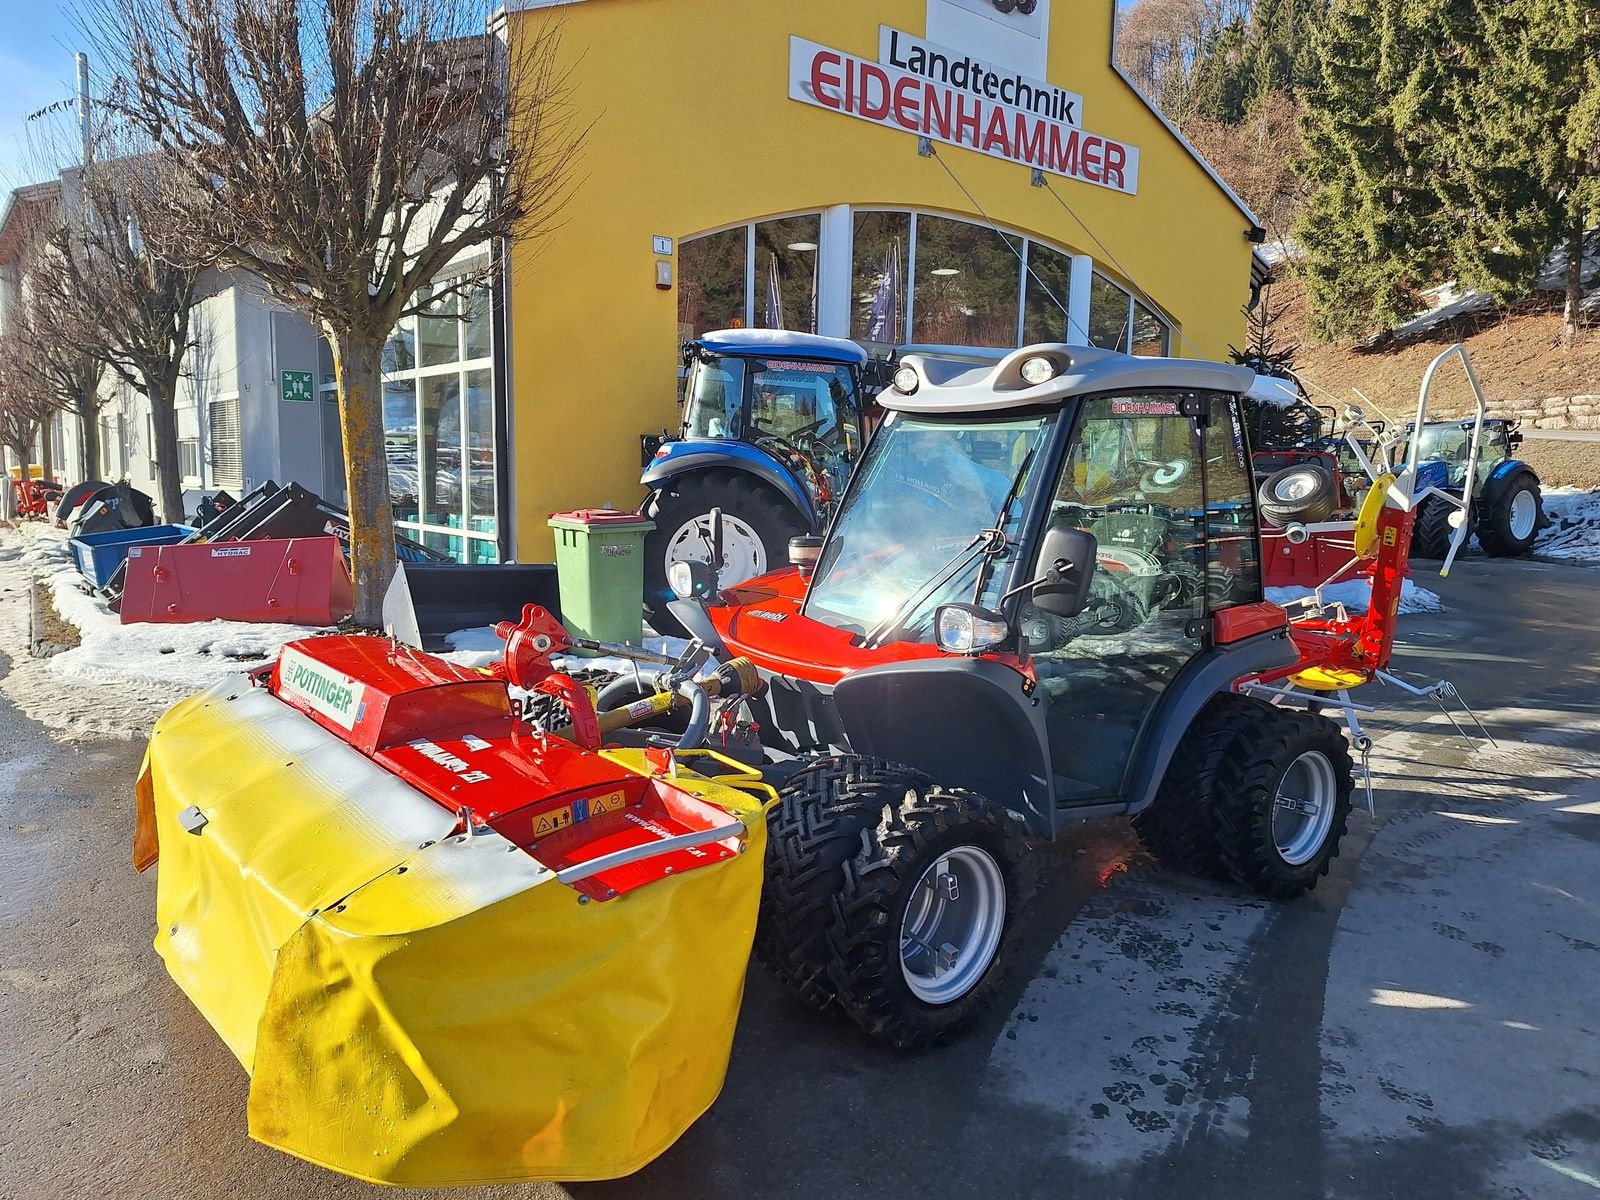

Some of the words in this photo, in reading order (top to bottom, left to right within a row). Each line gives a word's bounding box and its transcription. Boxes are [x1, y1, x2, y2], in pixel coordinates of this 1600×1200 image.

[889, 30, 1075, 124] Landtechnik
[811, 50, 1126, 189] EIDENHAMMER
[661, 240, 665, 250] 1
[766, 360, 836, 374] EIDENHAMMER
[1111, 402, 1178, 415] EIDENHAMMER
[217, 549, 249, 557] HYDRAC
